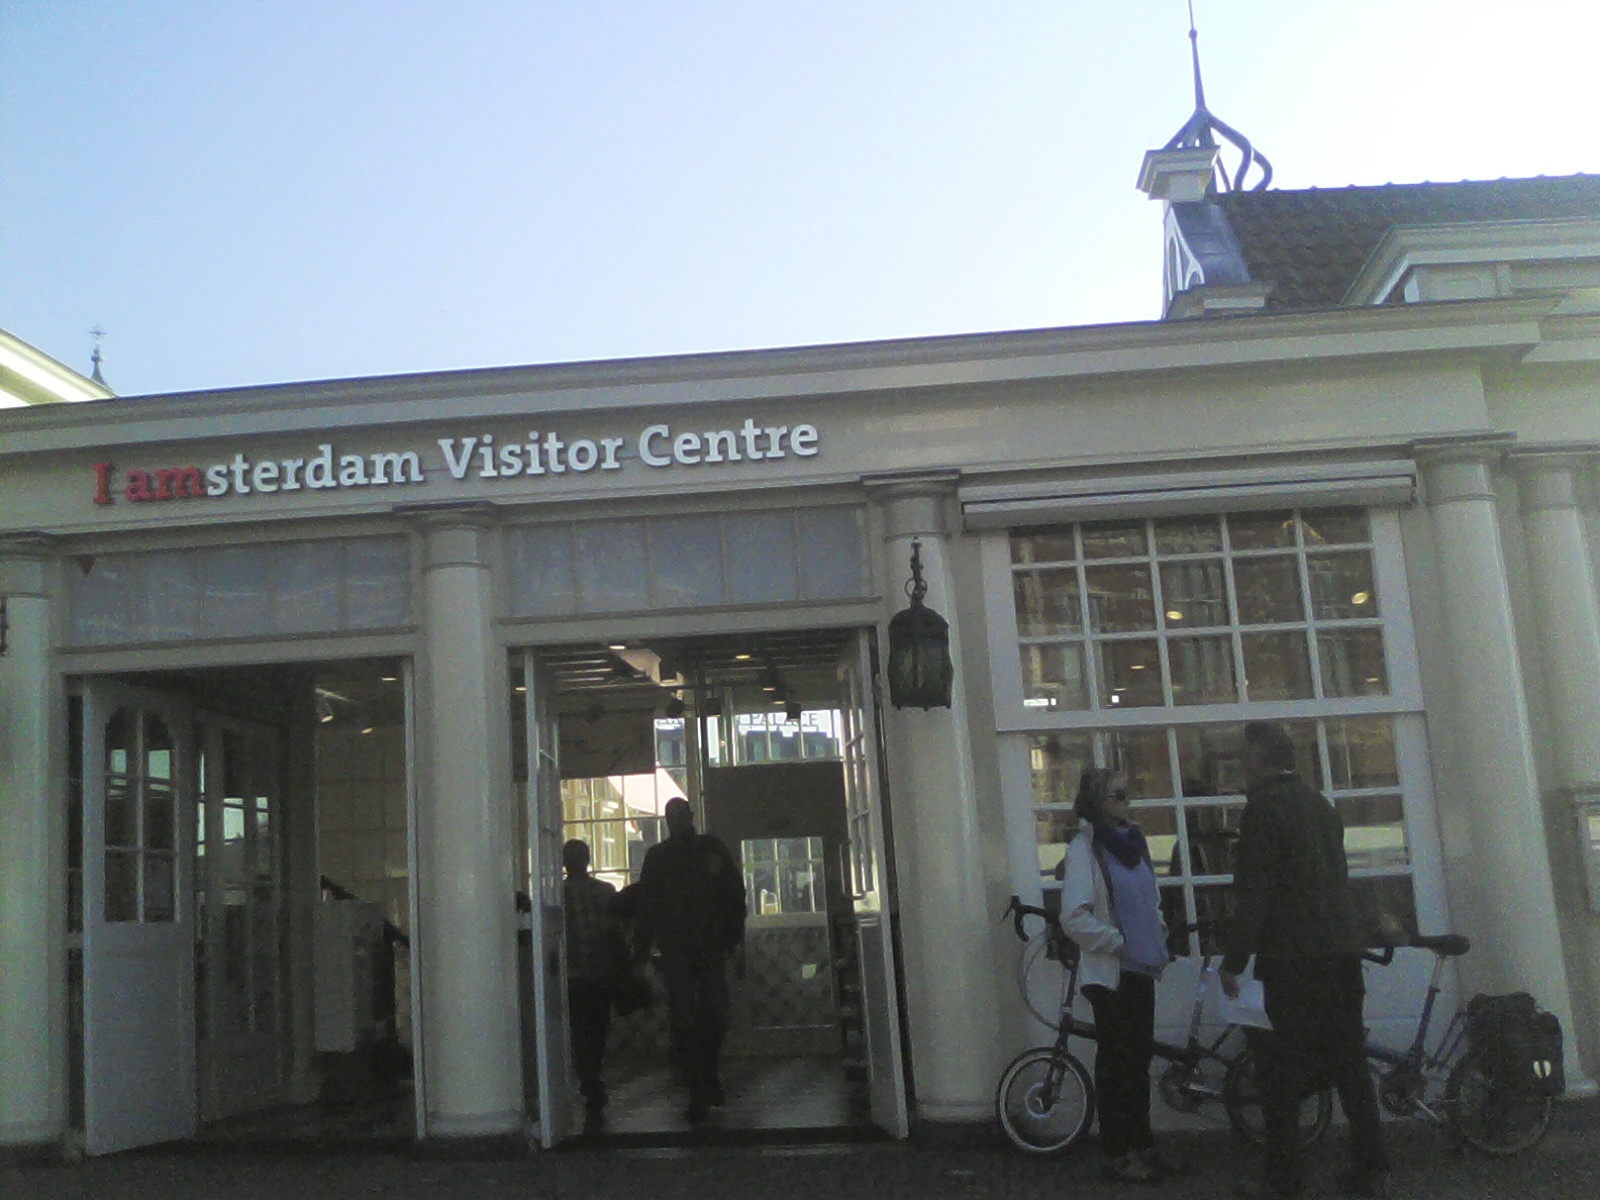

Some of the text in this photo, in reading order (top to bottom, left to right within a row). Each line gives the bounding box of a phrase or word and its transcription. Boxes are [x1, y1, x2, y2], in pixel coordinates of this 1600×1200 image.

[93, 418, 819, 505] I amsterdam Visitor Centre
